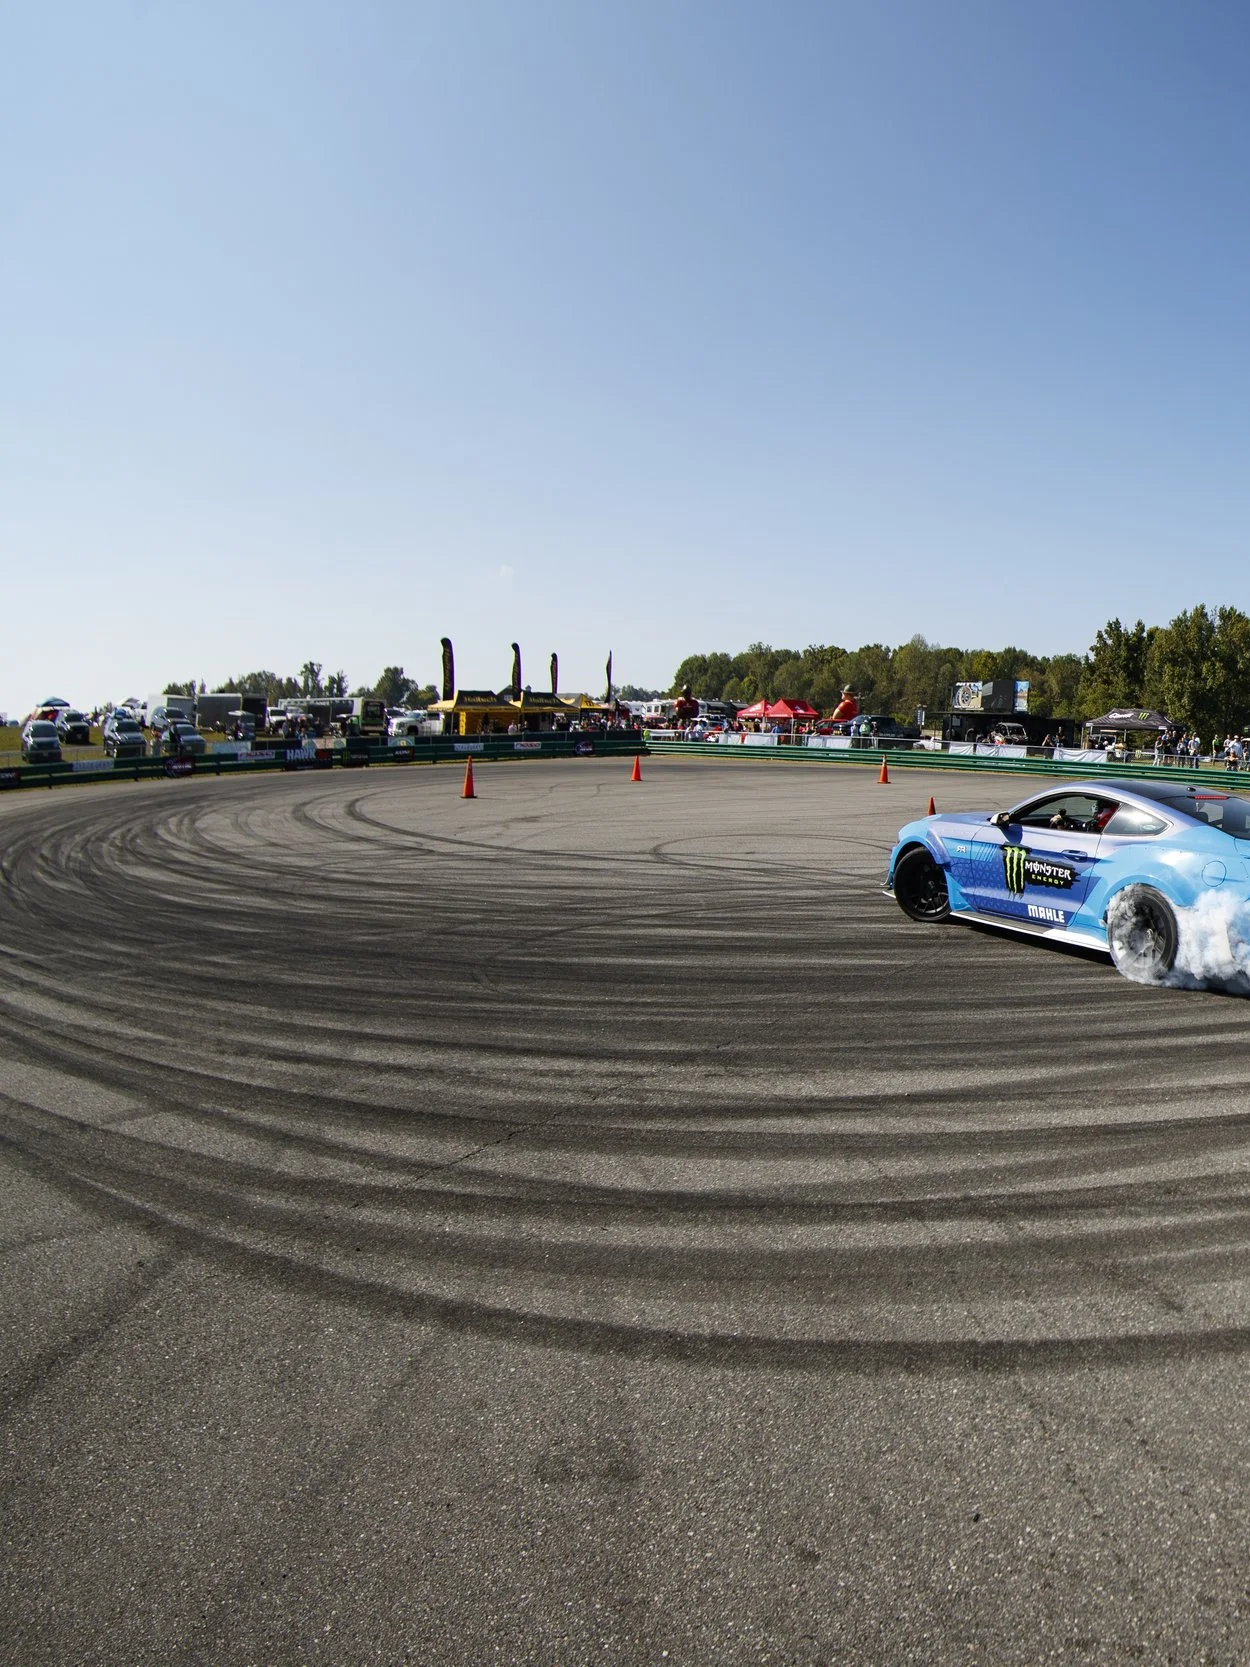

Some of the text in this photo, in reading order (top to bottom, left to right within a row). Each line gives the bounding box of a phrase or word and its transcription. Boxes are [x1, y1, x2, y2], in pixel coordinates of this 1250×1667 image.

[286, 749, 317, 760] HAWK
[1025, 860, 1072, 880] MONSTER
[1031, 874, 1064, 886] ENERGY
[1027, 904, 1065, 923] MAHLE
